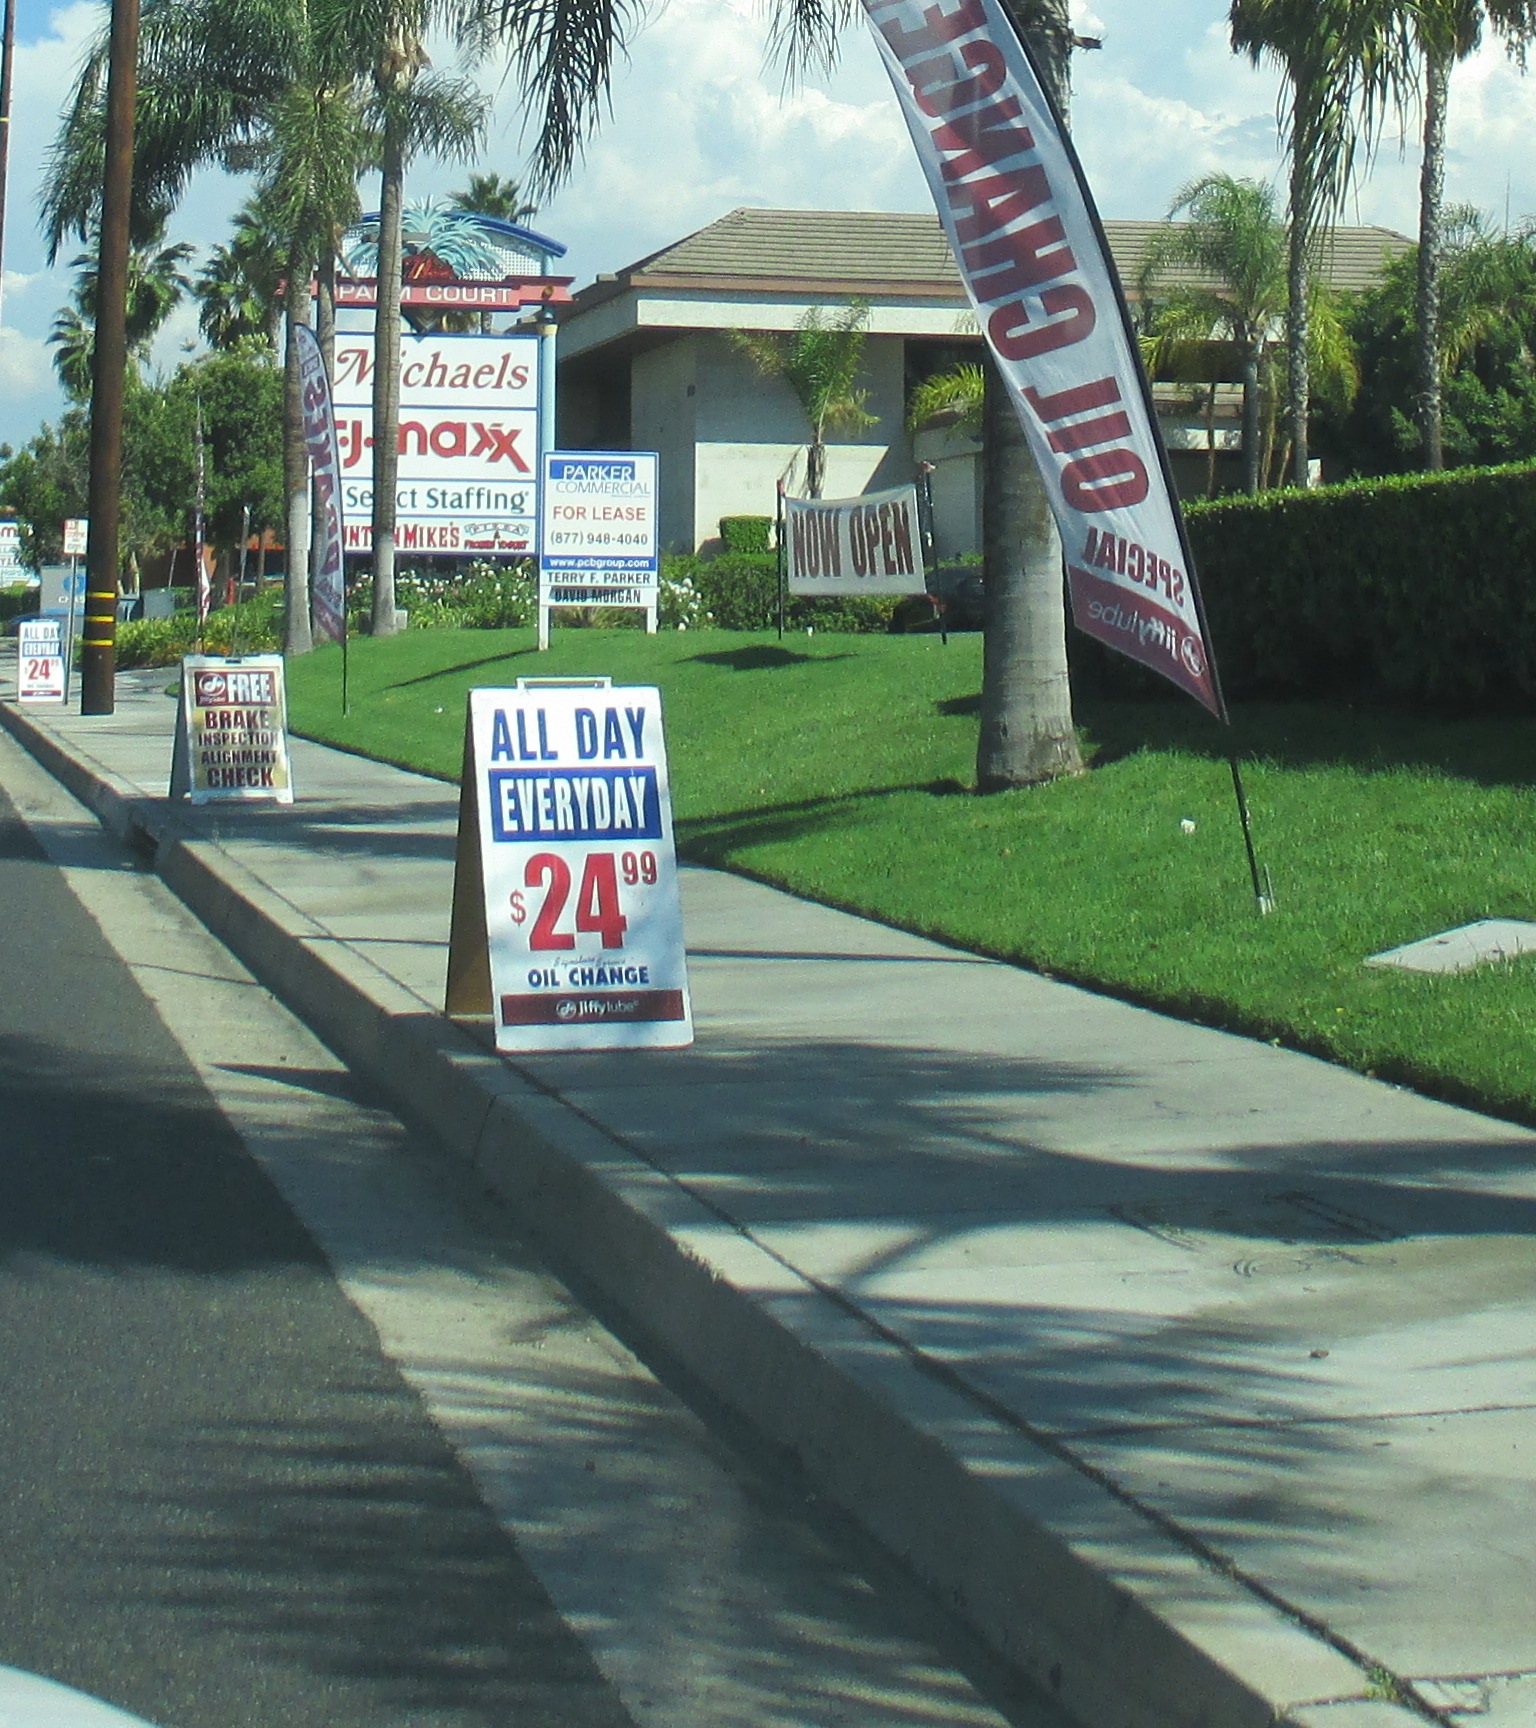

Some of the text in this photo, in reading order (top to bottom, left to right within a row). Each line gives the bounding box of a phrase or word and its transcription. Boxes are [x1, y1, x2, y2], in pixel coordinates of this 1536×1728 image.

[426, 285, 511, 303] COURT
[564, 465, 632, 480] PARKER
[556, 481, 651, 494] COMMERCIAL
[346, 485, 526, 514] Sect Staffing
[553, 506, 646, 521] FOR LEASE
[550, 531, 648, 545] (877) 948-4040
[792, 500, 914, 579] NOW OPEN
[550, 558, 650, 569] www.pcbgroup.com
[548, 572, 650, 584] TERRY F. PARKER
[553, 588, 641, 603] DAVID MORGAN
[24, 627, 40, 640] ALL
[227, 674, 272, 702] FREE
[205, 710, 270, 729] BRAKE
[198, 732, 278, 746] INSPECTION
[491, 707, 645, 762] ALL DAY
[201, 750, 278, 764] ALIGNMENT
[207, 767, 274, 787] CHECK
[499, 776, 647, 833] EVERYDAY
[528, 965, 649, 987] OIL CHANGE
